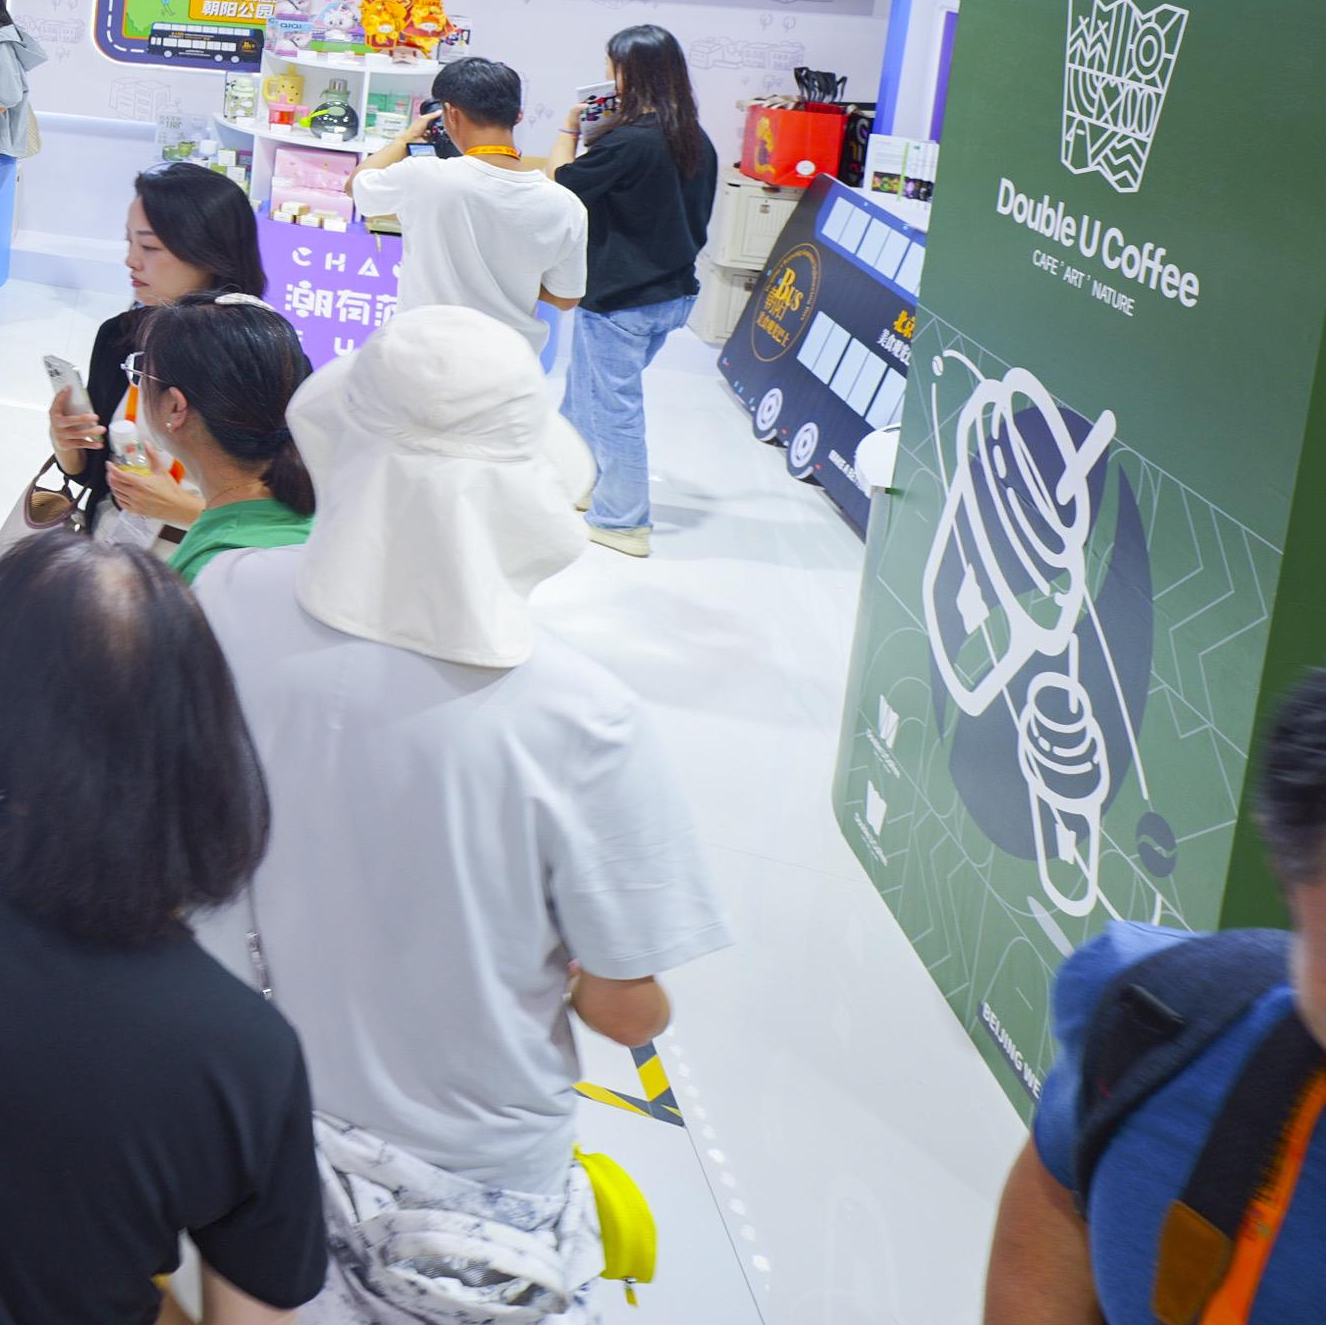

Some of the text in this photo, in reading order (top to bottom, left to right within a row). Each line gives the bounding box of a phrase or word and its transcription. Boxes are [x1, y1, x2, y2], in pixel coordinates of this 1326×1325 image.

[996, 177, 1200, 308] Double U Coffee
[1091, 280, 1136, 317] NATURE
[981, 1002, 1026, 1073] BEIJING
